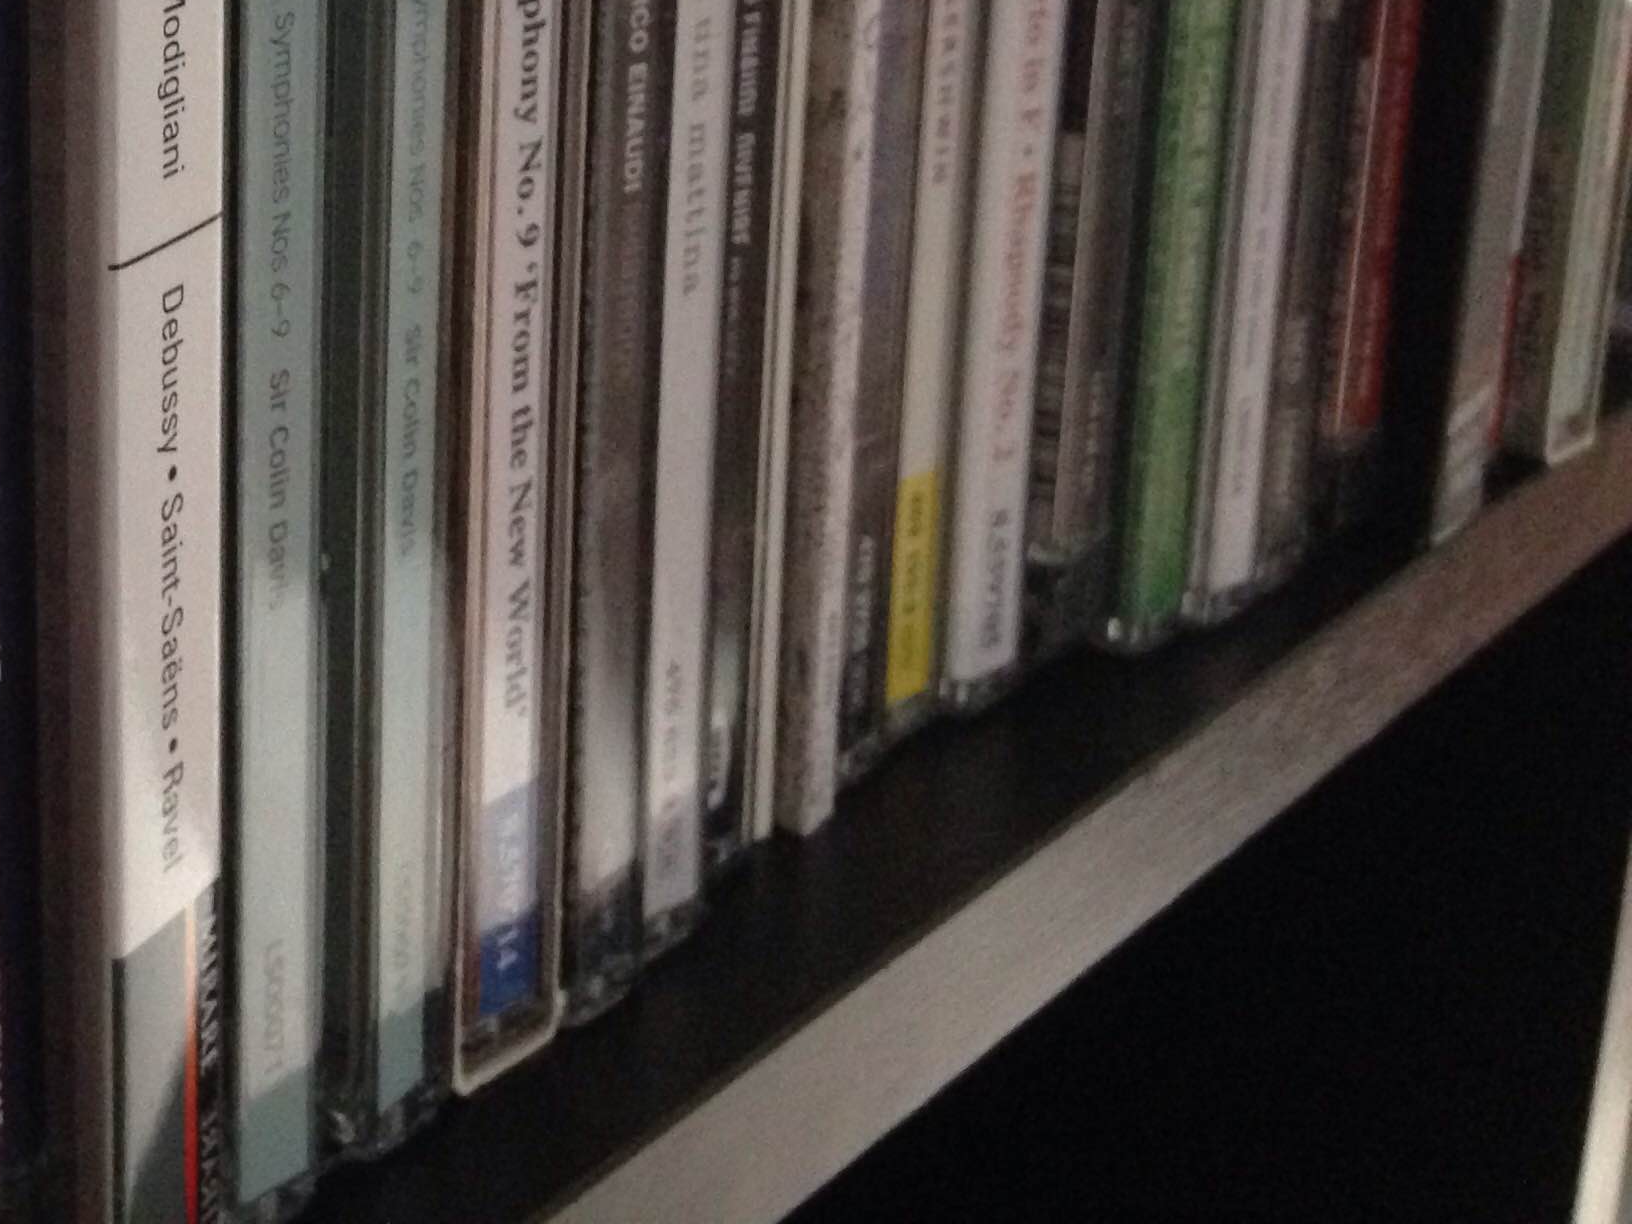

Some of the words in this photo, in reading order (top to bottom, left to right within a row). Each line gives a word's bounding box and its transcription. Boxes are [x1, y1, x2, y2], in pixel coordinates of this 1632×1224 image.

[269, 9, 296, 206] Symphonies
[622, 60, 648, 194] EINAUDI
[272, 211, 291, 274] Nos
[681, 122, 717, 296] mattina
[159, 284, 185, 454] Debussy
[269, 367, 291, 413] Sir
[402, 377, 423, 452] Colin
[269, 425, 291, 510] Colin
[510, 405, 535, 466] the
[400, 466, 422, 557] Davis
[507, 482, 535, 576] New
[160, 493, 185, 730] Saint-Saëns
[269, 522, 291, 613] Davis
[162, 760, 184, 873] Ravel
